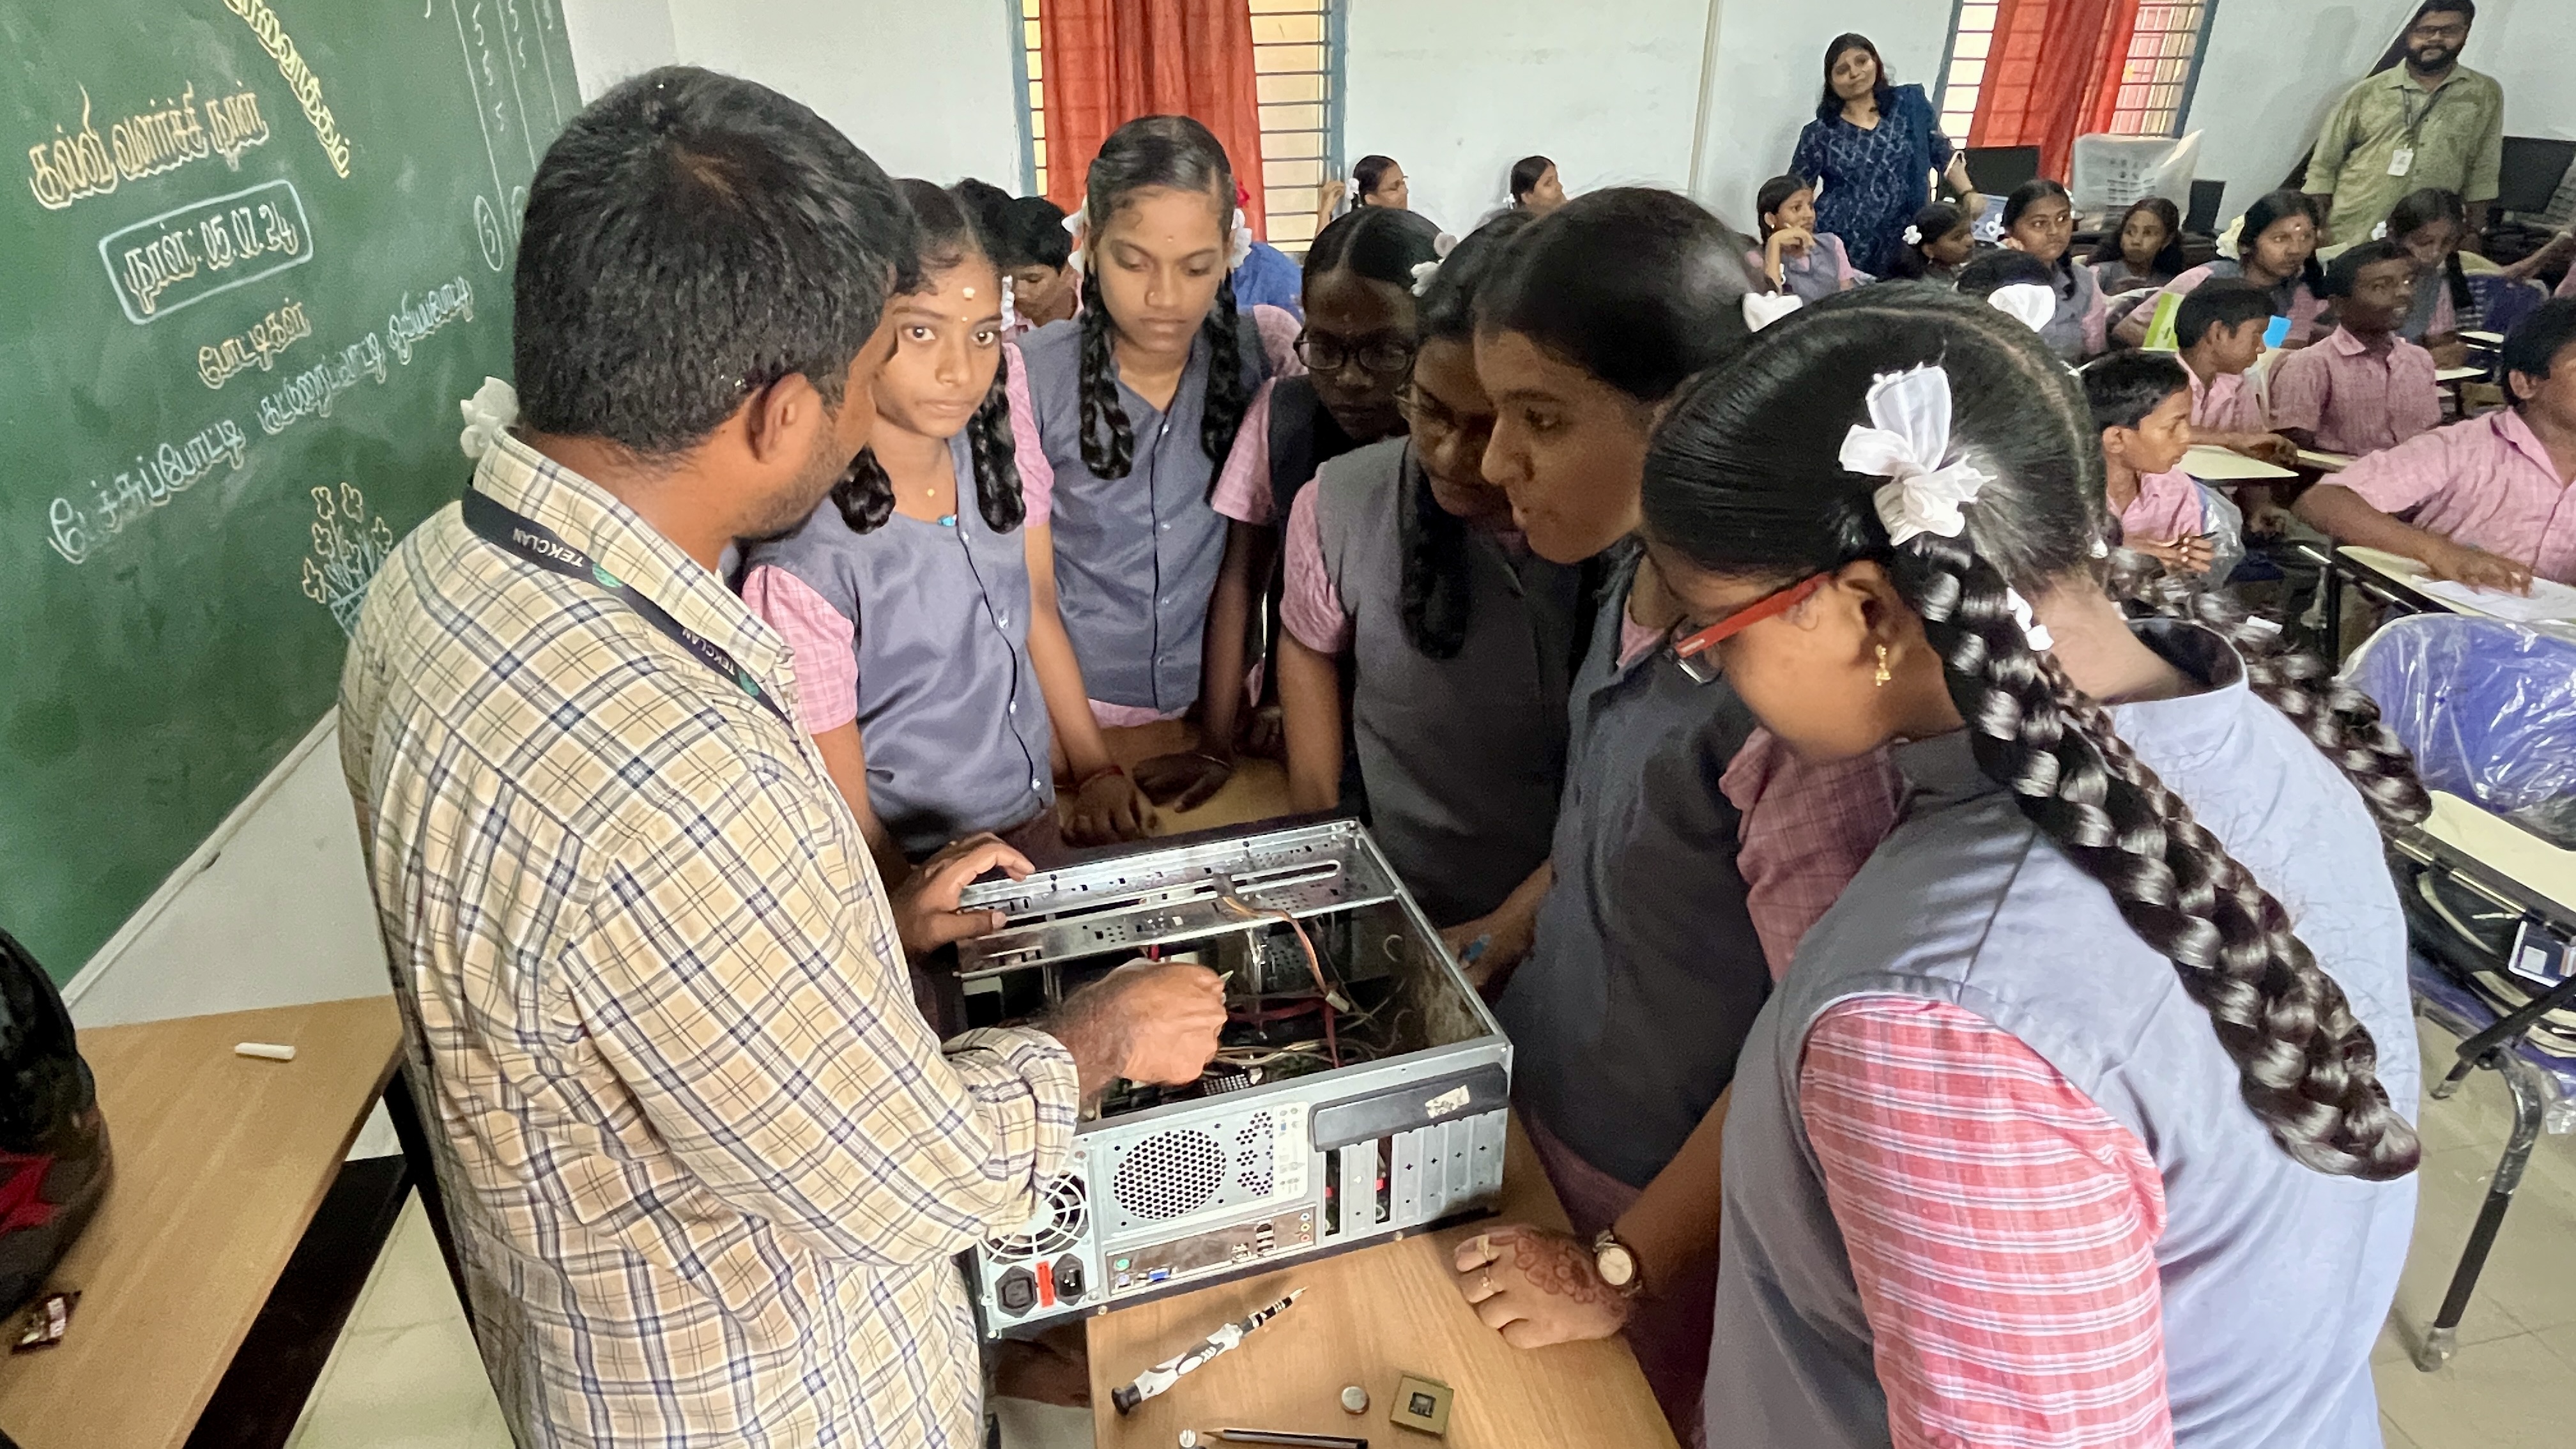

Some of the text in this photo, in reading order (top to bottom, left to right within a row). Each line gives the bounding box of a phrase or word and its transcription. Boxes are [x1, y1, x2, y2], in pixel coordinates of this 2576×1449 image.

[29, 81, 118, 210] கல்வி
[205, 80, 270, 171] நாள்
[200, 201, 299, 271] 05.07.24
[198, 296, 312, 390] போட்டிகள்
[513, 526, 584, 568] TEKCLAN
[682, 629, 735, 676] TEKCLAN
